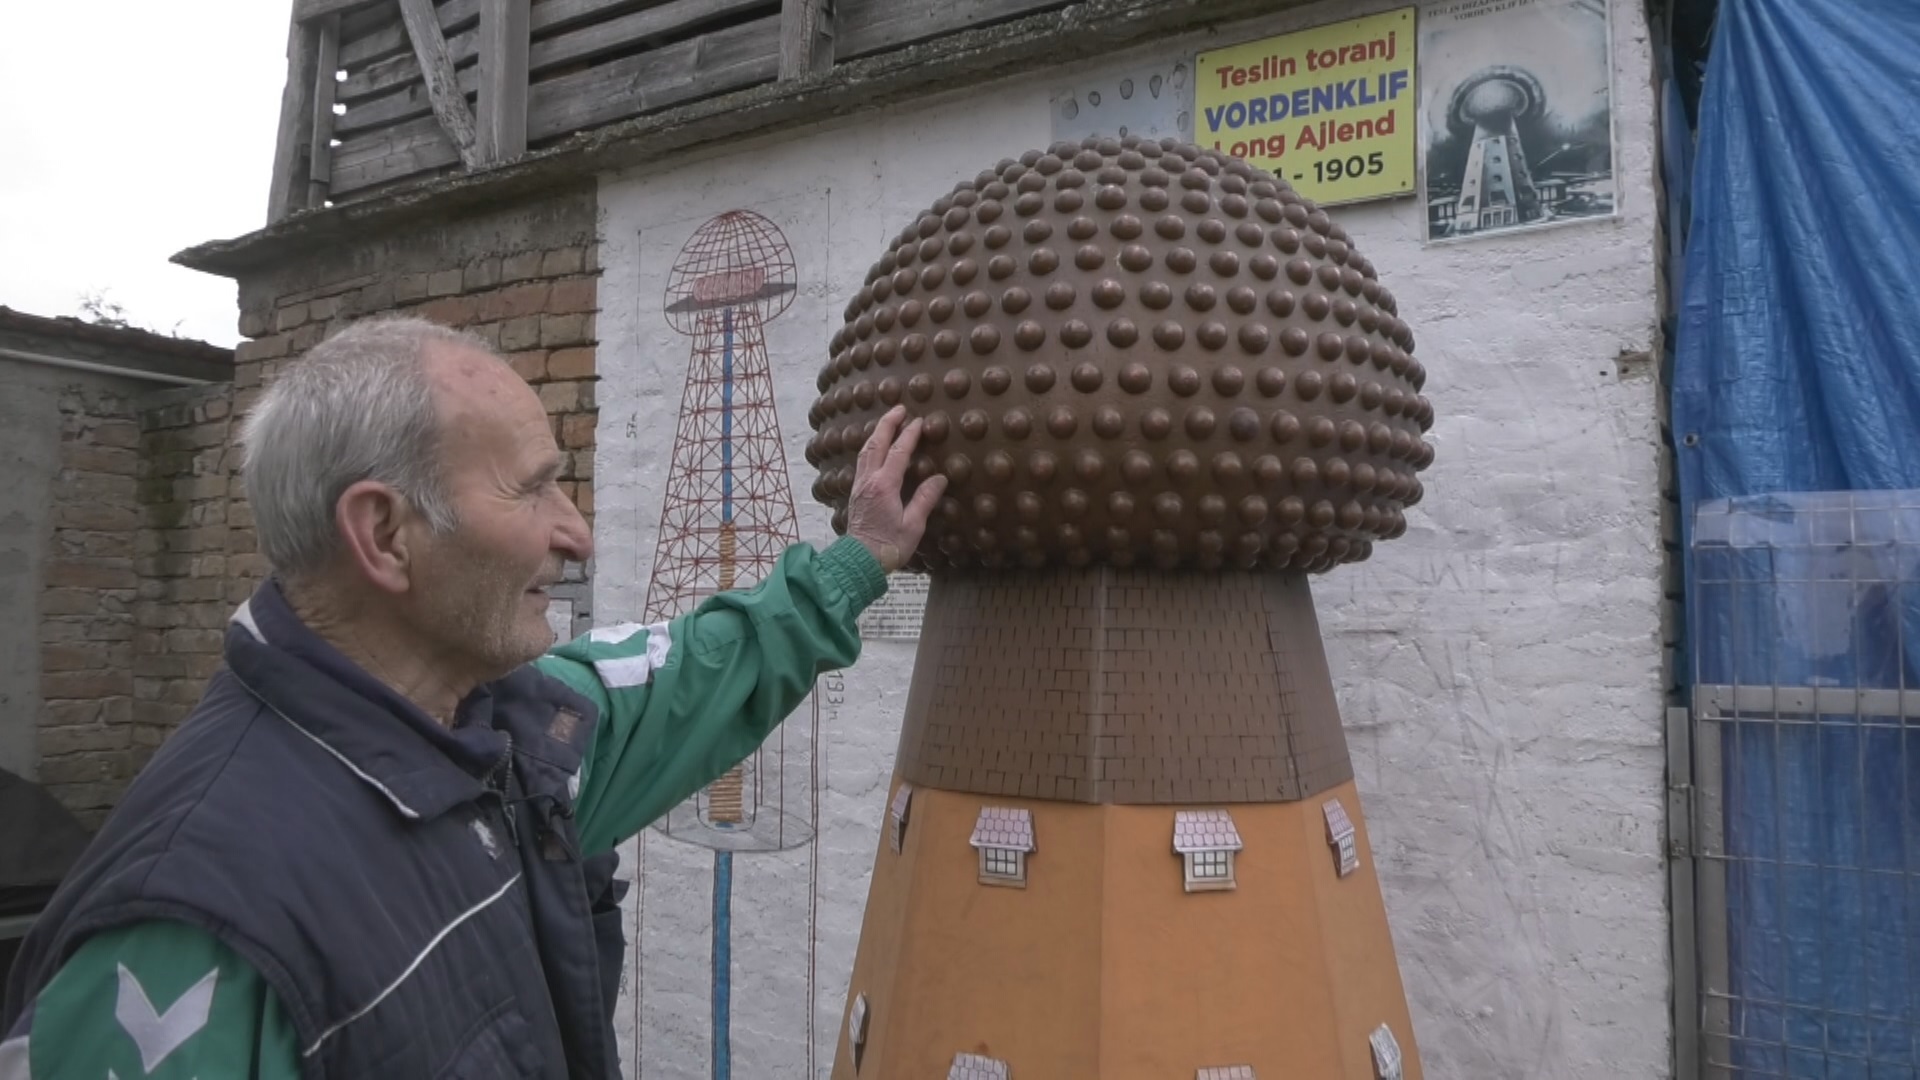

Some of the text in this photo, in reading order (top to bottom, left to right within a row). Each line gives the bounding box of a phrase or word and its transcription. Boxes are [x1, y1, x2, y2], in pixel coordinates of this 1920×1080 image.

[1454, 7, 1492, 21] VORDEN
[1216, 31, 1396, 89] Teslin toranj
[1204, 69, 1408, 132] VORDENKLIF
[1295, 109, 1395, 151] Ajlend
[1313, 151, 1384, 183] 1905
